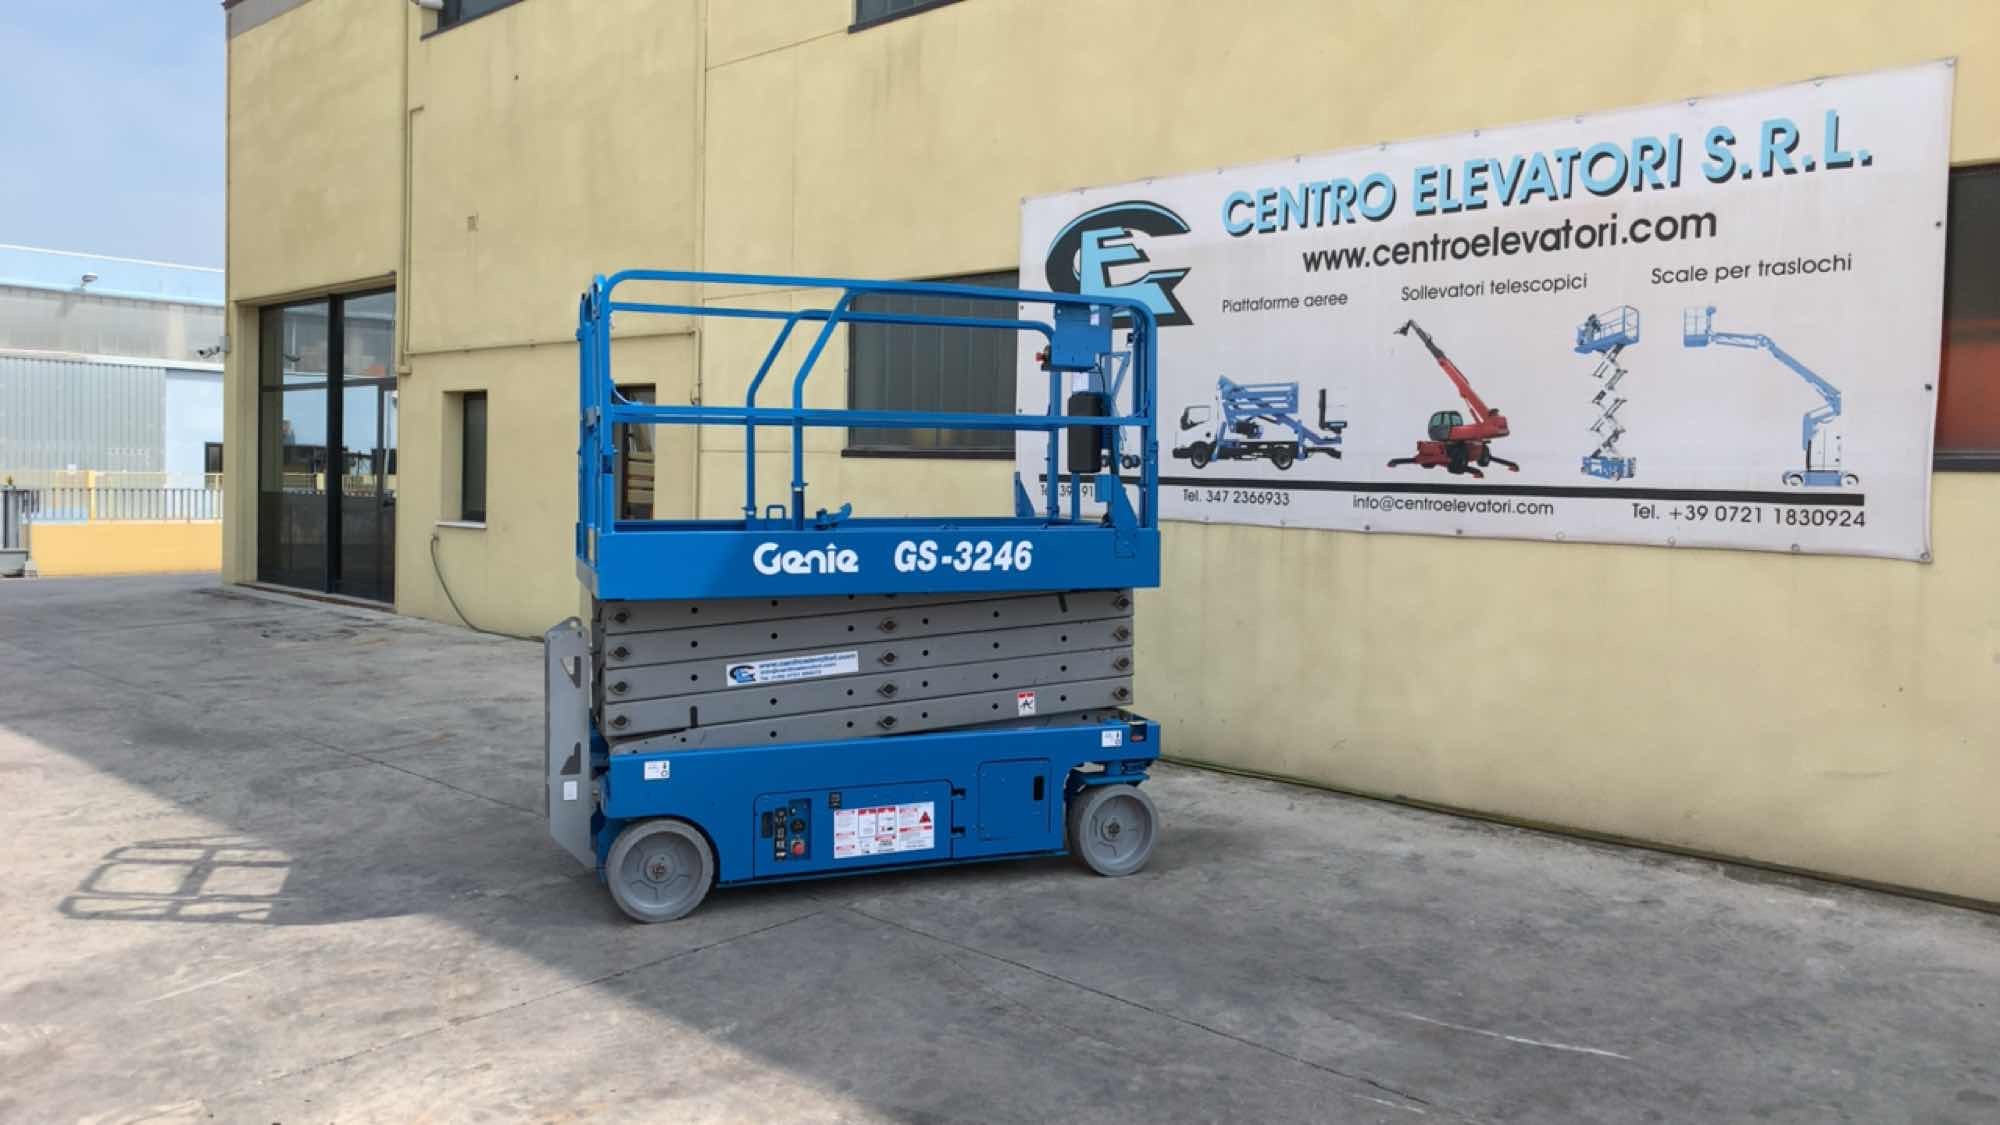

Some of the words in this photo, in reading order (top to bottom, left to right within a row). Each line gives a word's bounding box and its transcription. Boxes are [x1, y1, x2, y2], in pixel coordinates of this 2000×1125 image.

[1221, 172, 1396, 237] CENTRO
[1413, 132, 1682, 215] ELEVATORI
[1702, 109, 1873, 183] S.R.L.
[1302, 211, 1718, 273] www.centroelevatori.com
[1651, 265, 1708, 285] Scale
[1714, 264, 1750, 284] per
[1758, 252, 1853, 277] traslochi
[1401, 281, 1485, 302] Sollevatori
[1489, 272, 1588, 295] telescopici
[1221, 296, 1300, 313] Piattaforme
[1303, 292, 1348, 307] aeree
[1183, 488, 1202, 502] Tel.
[1206, 489, 1229, 504] 347
[1232, 490, 1290, 507] 2366933
[1353, 494, 1554, 516] info@centroelevatori.com
[1632, 502, 1661, 519] Tel.
[1669, 505, 1709, 522] +39
[1715, 505, 1763, 523] 0721
[1774, 508, 1866, 528] 1830924
[752, 542, 859, 576] Genie
[894, 540, 1033, 573] GS-3246
